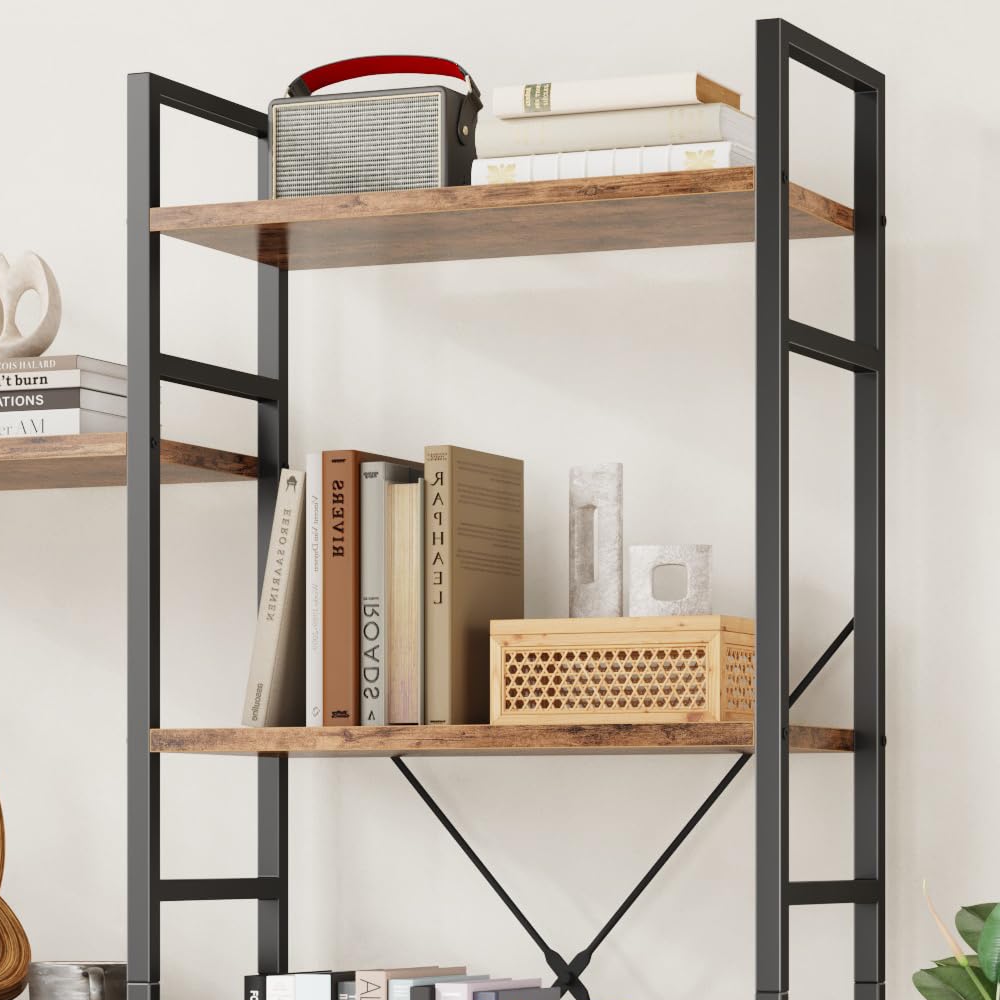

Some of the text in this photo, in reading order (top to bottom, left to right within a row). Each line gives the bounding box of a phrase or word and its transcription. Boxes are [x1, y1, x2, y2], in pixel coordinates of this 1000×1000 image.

[19, 359, 56, 369] HALARD
[15, 375, 48, 386] burn
[19, 418, 46, 434] AM
